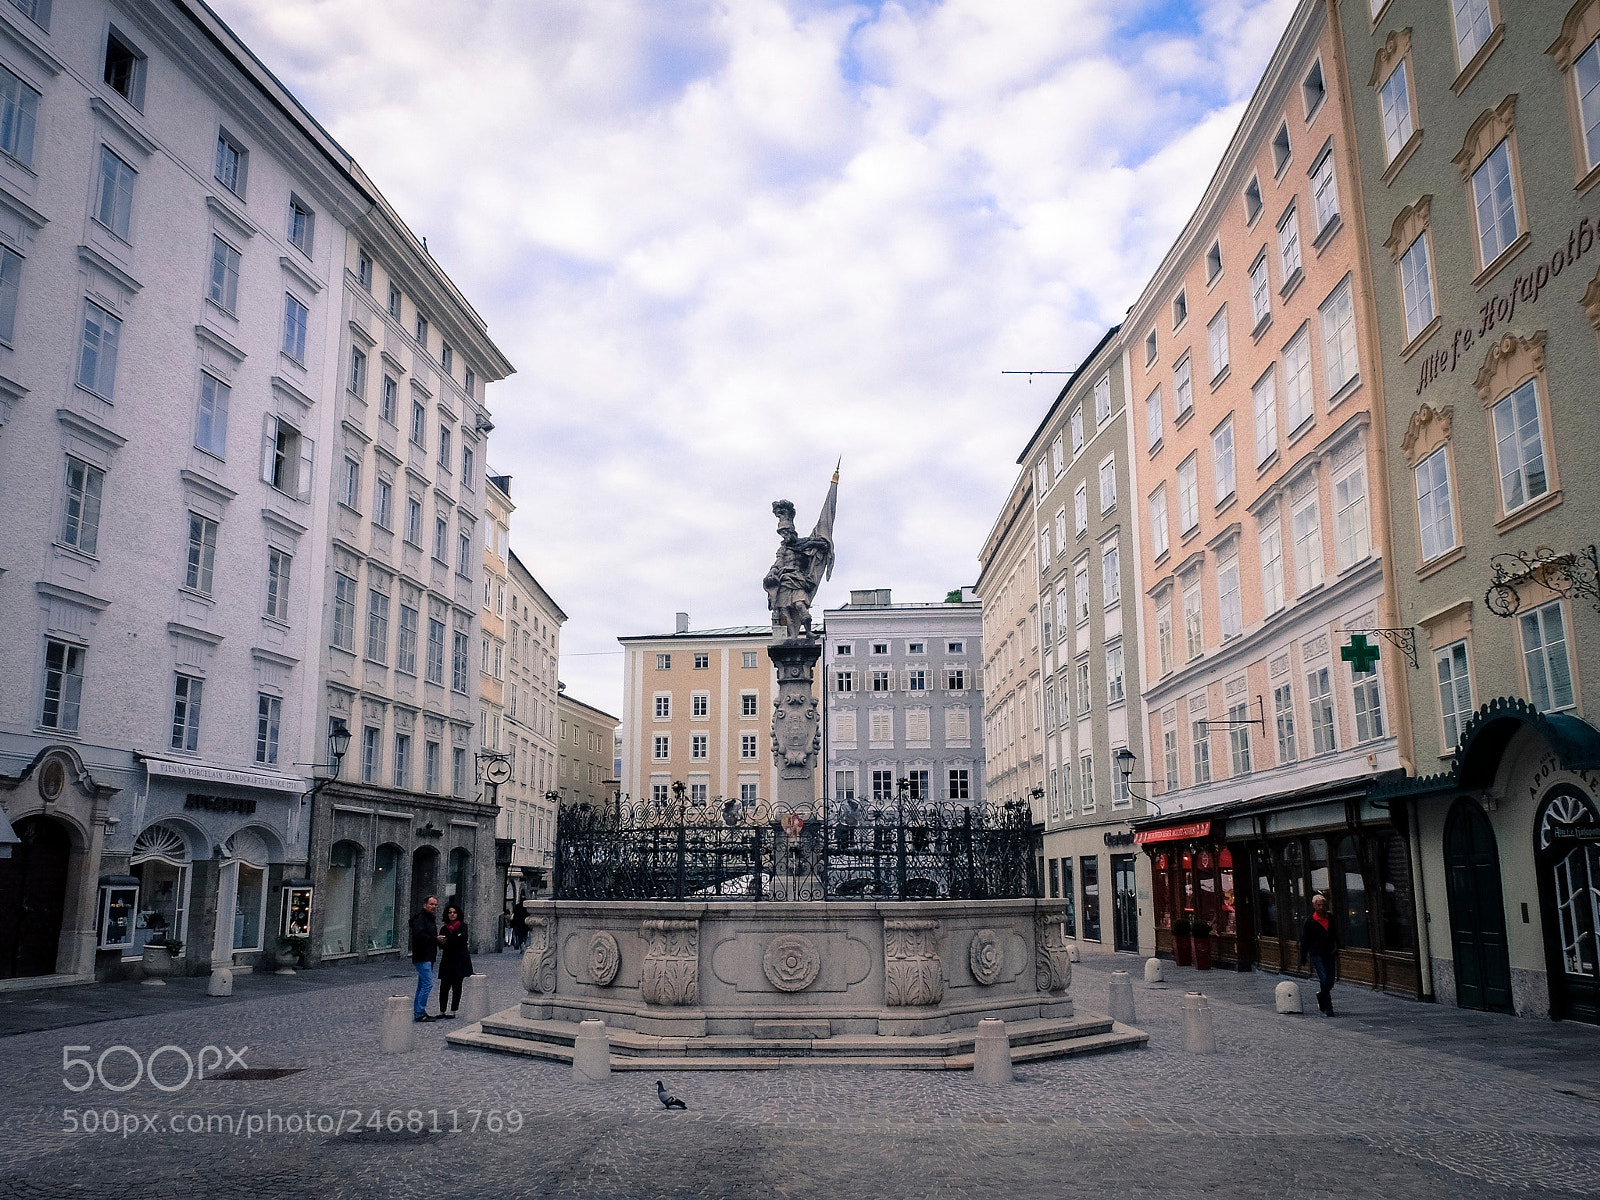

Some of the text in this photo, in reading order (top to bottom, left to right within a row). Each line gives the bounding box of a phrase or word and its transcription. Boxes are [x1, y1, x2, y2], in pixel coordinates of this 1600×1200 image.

[1478, 217, 1600, 338] Hofapoth
[160, 764, 187, 775] VIENNA
[188, 768, 223, 780] PORCELAIN
[226, 773, 269, 785] HANDCRAFTED
